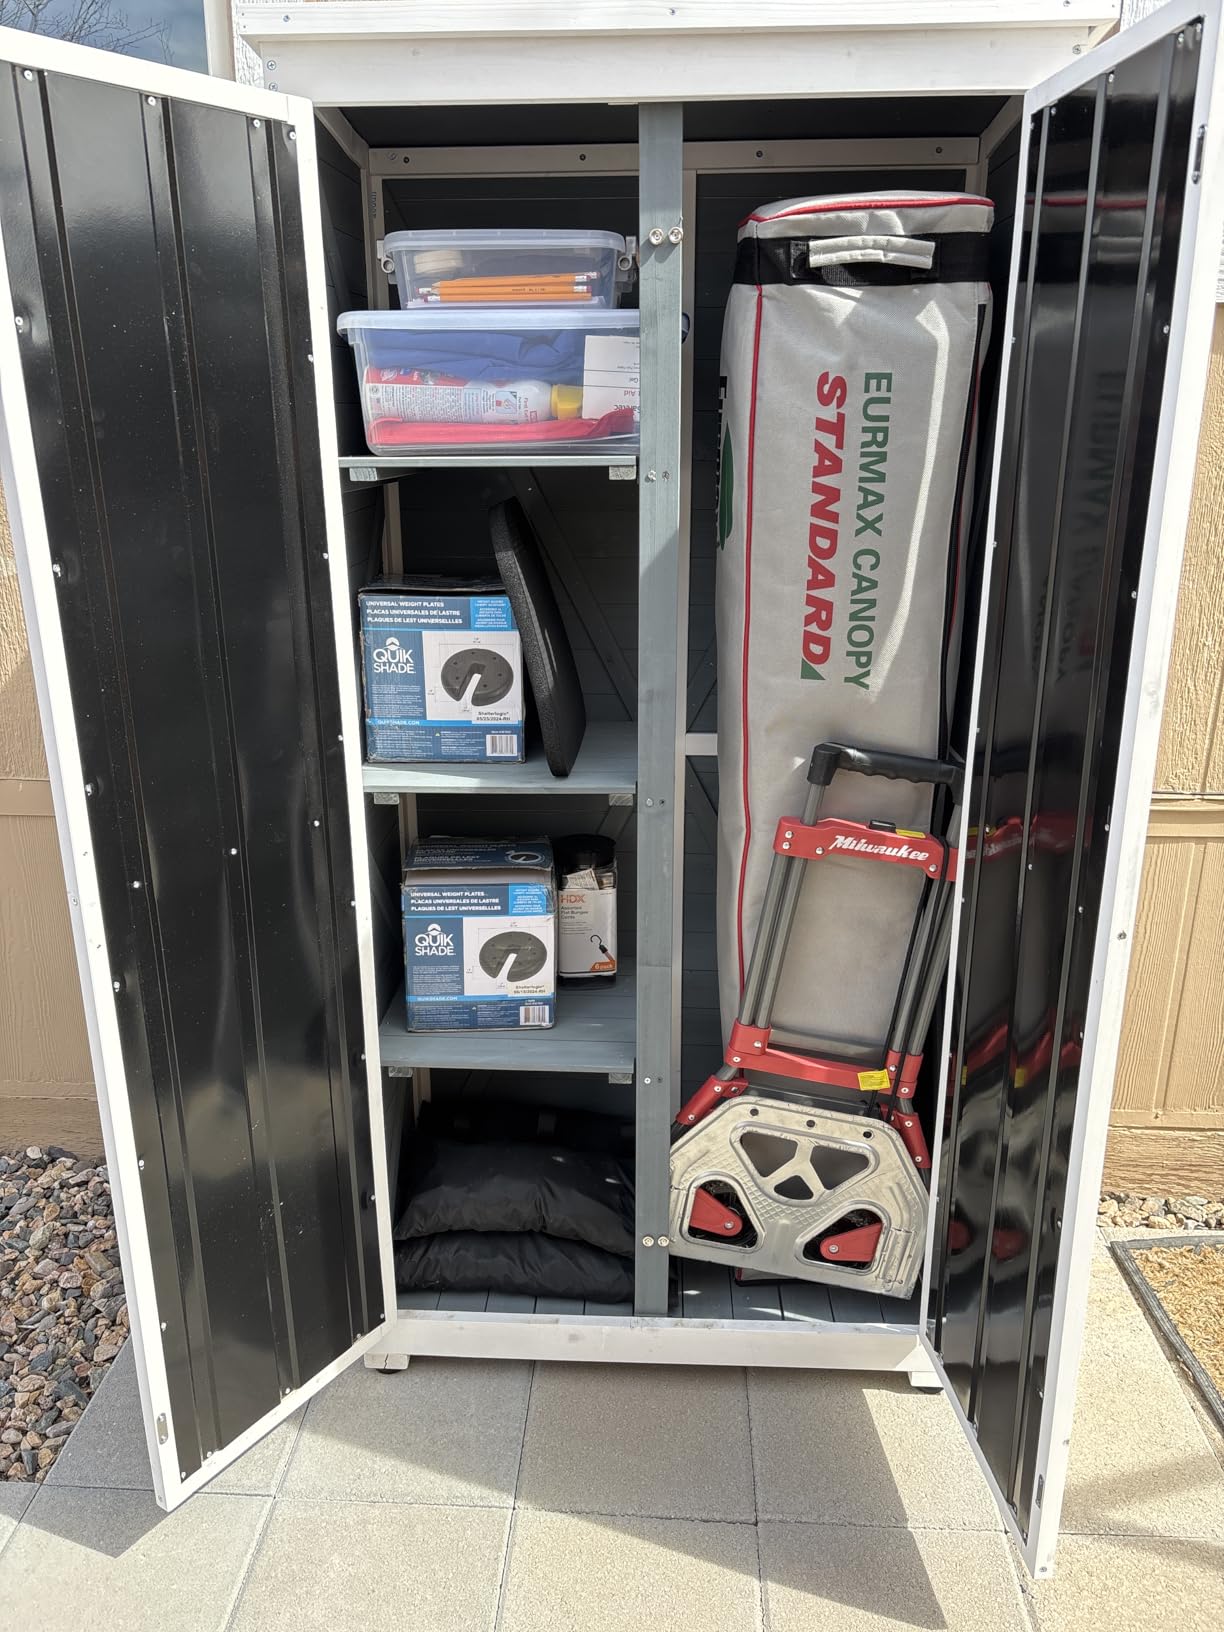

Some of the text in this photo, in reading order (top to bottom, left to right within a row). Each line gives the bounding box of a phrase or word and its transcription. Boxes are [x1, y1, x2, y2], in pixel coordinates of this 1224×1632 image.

[801, 370, 848, 666] STANDARD
[843, 371, 894, 691] EURMAX CANOPY
[373, 648, 414, 663] QUIK
[373, 663, 415, 674] SHADE
[828, 834, 930, 861] Milwaukee
[561, 895, 586, 904] HDX
[415, 932, 454, 947] QUIK
[415, 947, 456, 956] SHADE
